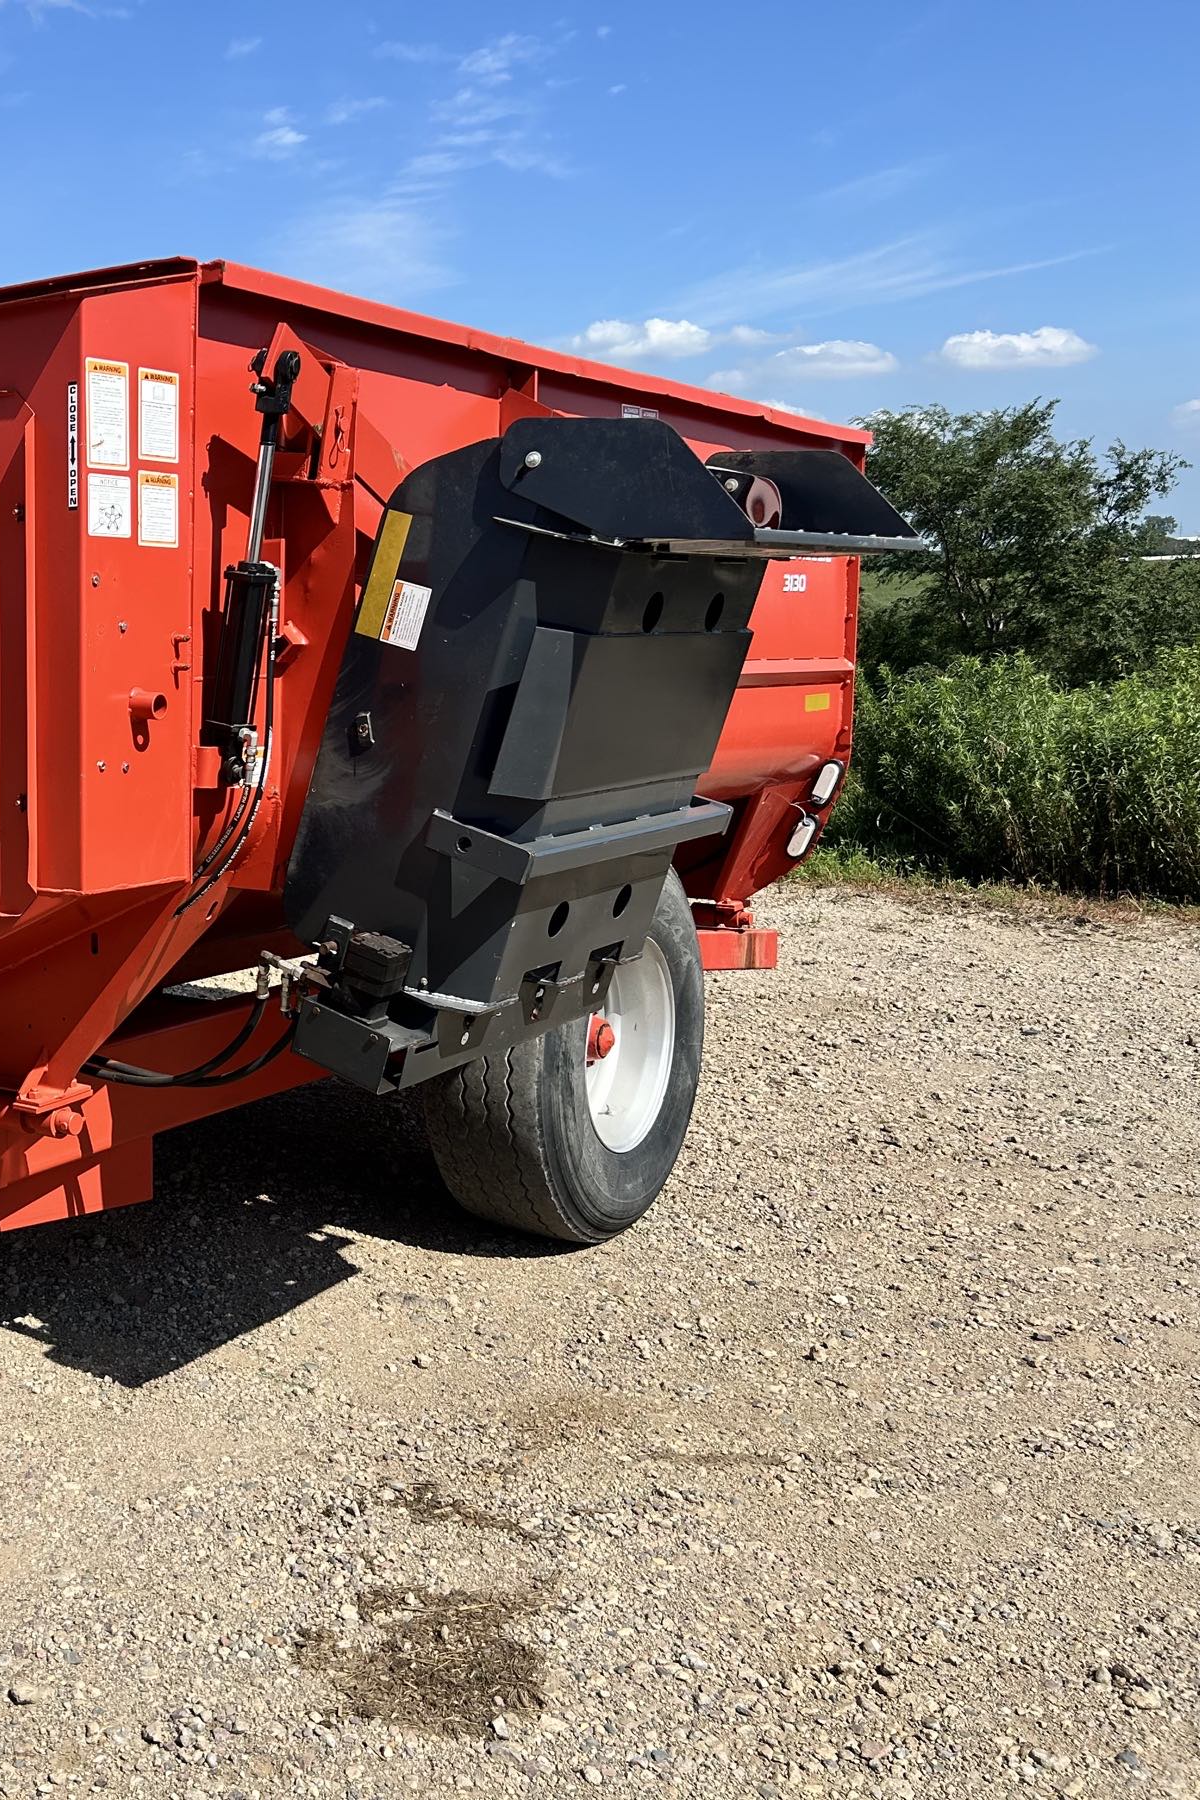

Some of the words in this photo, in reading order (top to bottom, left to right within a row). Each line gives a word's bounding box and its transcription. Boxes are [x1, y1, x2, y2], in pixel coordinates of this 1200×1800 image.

[99, 365, 121, 374] WARNING
[150, 374, 173, 383] WARNING
[69, 386, 77, 432] CLOSE
[100, 479, 119, 487] NOTICE
[150, 477, 172, 486] WARNING
[69, 469, 77, 505] OPEN
[387, 592, 400, 624] WARNING
